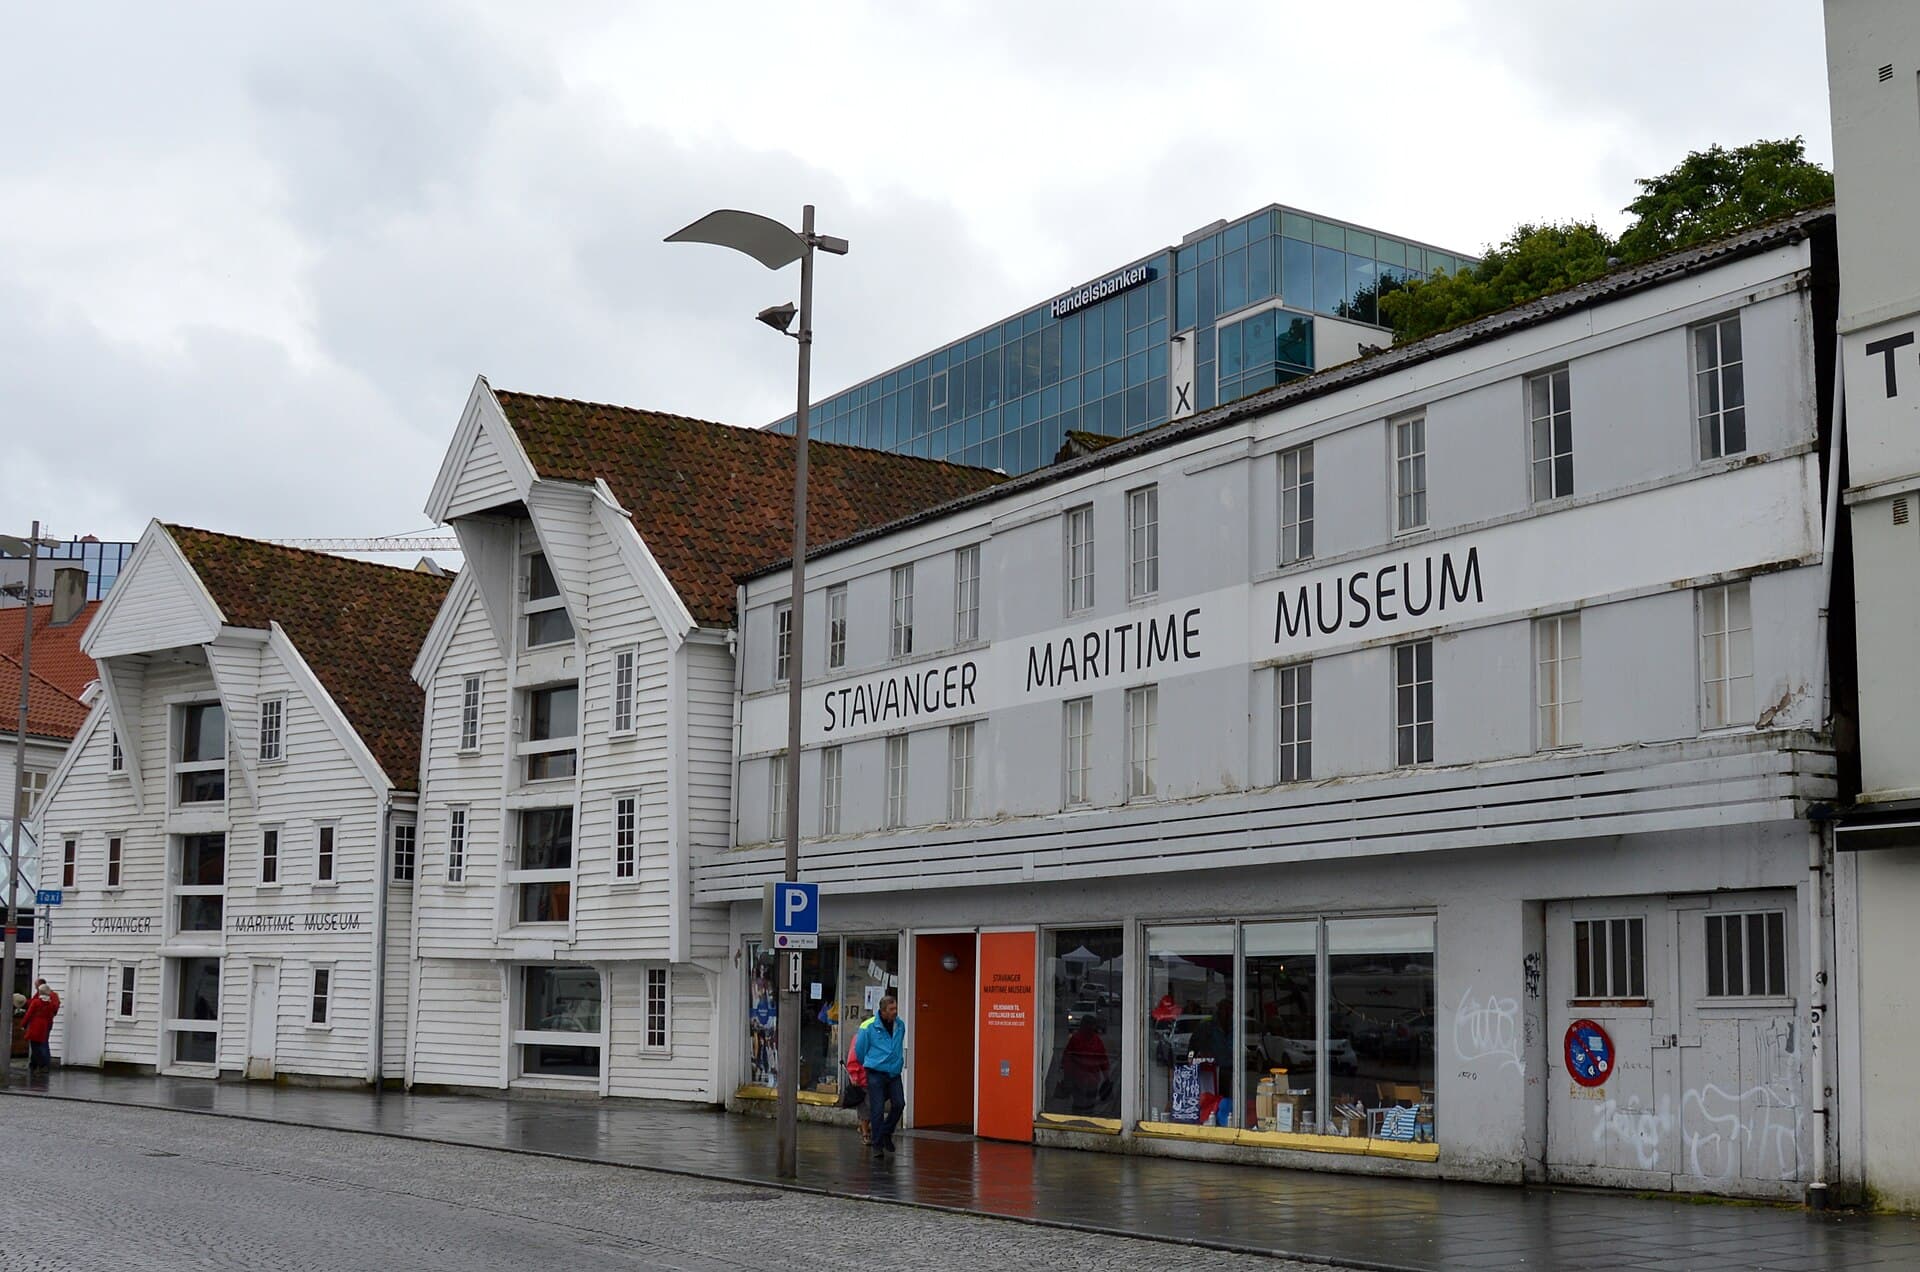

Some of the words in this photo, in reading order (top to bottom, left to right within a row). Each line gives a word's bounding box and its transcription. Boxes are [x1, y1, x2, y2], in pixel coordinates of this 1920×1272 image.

[1050, 264, 1147, 318] Handelsbanken
[1866, 331, 1920, 398] T
[823, 661, 977, 732] STAVANGER
[1026, 608, 1201, 692] MARITIME
[1274, 546, 1484, 644] MUSEUM
[39, 891, 60, 902] Taxi
[785, 888, 808, 927] P
[91, 916, 151, 933] STAVANGER
[235, 915, 295, 933] MARITIME
[304, 913, 361, 931] MUSEUM
[984, 985, 1007, 993] MARITIME
[1008, 985, 1032, 993] MUSEUM
[992, 974, 1021, 982] STAVANGER
